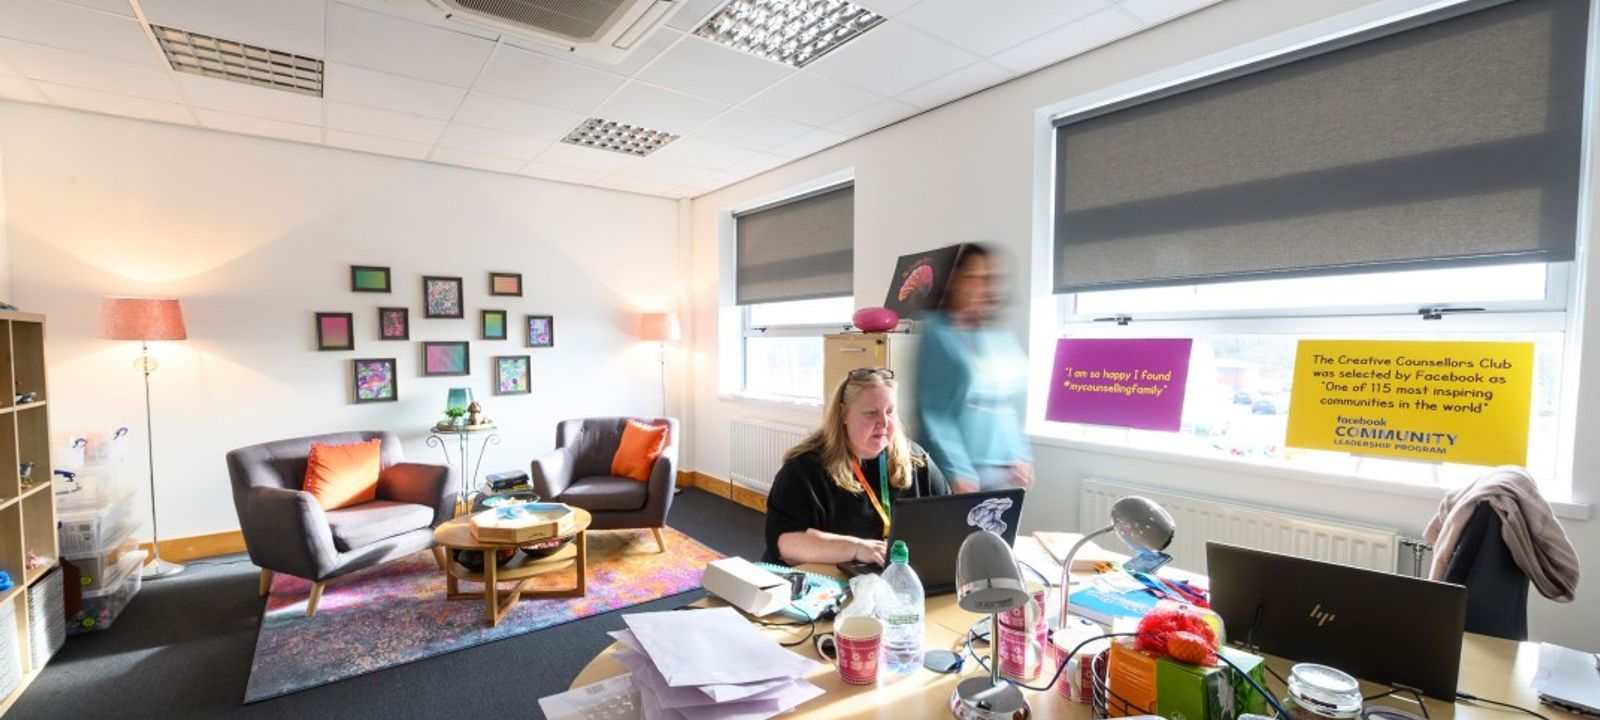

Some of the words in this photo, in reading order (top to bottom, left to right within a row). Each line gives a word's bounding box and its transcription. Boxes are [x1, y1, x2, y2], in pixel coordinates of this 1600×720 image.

[1312, 354, 1334, 365] The
[1338, 355, 1391, 365] Creative
[1396, 356, 1474, 368] Counsellors
[1479, 357, 1512, 369] Club
[1074, 370, 1088, 378] am
[1090, 371, 1100, 379] so
[1103, 369, 1131, 381] happy
[1134, 369, 1139, 379] I
[1141, 369, 1172, 381] found
[1313, 370, 1335, 378] was
[1339, 369, 1391, 379] selected
[1395, 369, 1411, 382] by
[1415, 370, 1484, 383] Facebook
[1489, 376, 1506, 384] as
[1352, 382, 1367, 392] of
[1371, 383, 1391, 393] 115
[1396, 385, 1428, 395] most
[1433, 388, 1493, 401] inspiring
[1320, 398, 1394, 408] communities
[1399, 400, 1410, 409] in
[1415, 399, 1438, 411] the
[1337, 415, 1386, 426] facebook
[1335, 426, 1458, 446] COMMUNITY
[1333, 439, 1392, 449] LEADERSHIP
[1394, 443, 1447, 454] PROGRAM
